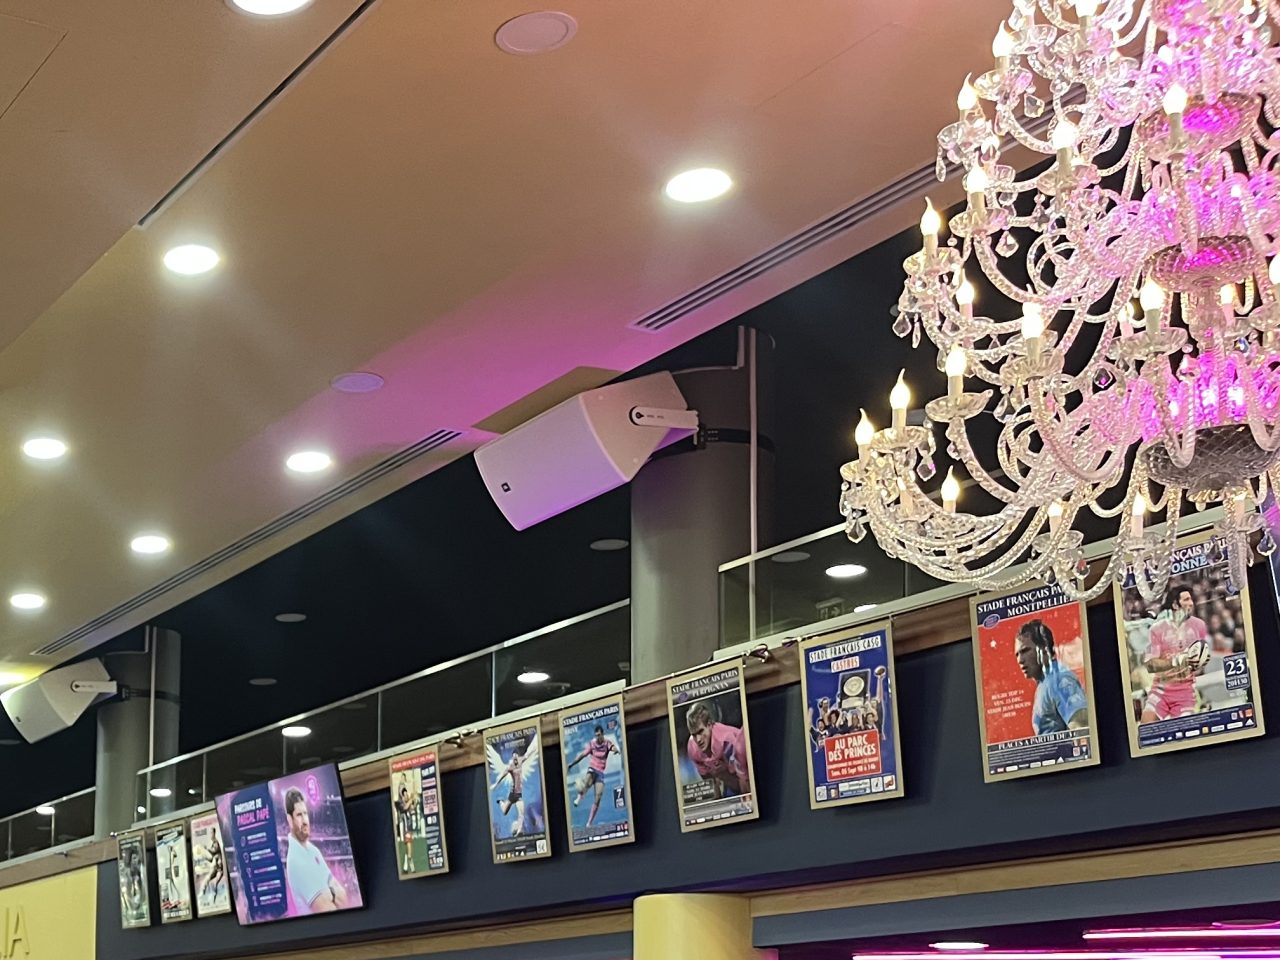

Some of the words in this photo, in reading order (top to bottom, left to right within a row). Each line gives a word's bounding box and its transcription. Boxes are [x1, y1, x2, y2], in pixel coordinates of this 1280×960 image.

[977, 600, 1005, 614] STADE
[1006, 588, 1050, 607] FRANÇAIS
[1007, 594, 1073, 617] MONTPELLIE
[810, 649, 828, 662] STADE
[832, 658, 858, 671] CASTRES
[1226, 658, 1245, 676] 23
[672, 681, 691, 692] STADE
[721, 669, 738, 680] PARIS
[692, 681, 730, 697] PERPIGNAN
[563, 716, 578, 726] STADE
[578, 709, 604, 722] FRANÇAIS
[604, 706, 619, 715] PARIS
[834, 738, 846, 750] AU
[847, 734, 868, 748] PARC
[1030, 734, 1055, 745] PARTIR
[828, 751, 842, 762] DES
[844, 743, 876, 759] PRINCES
[616, 788, 622, 799] 7
